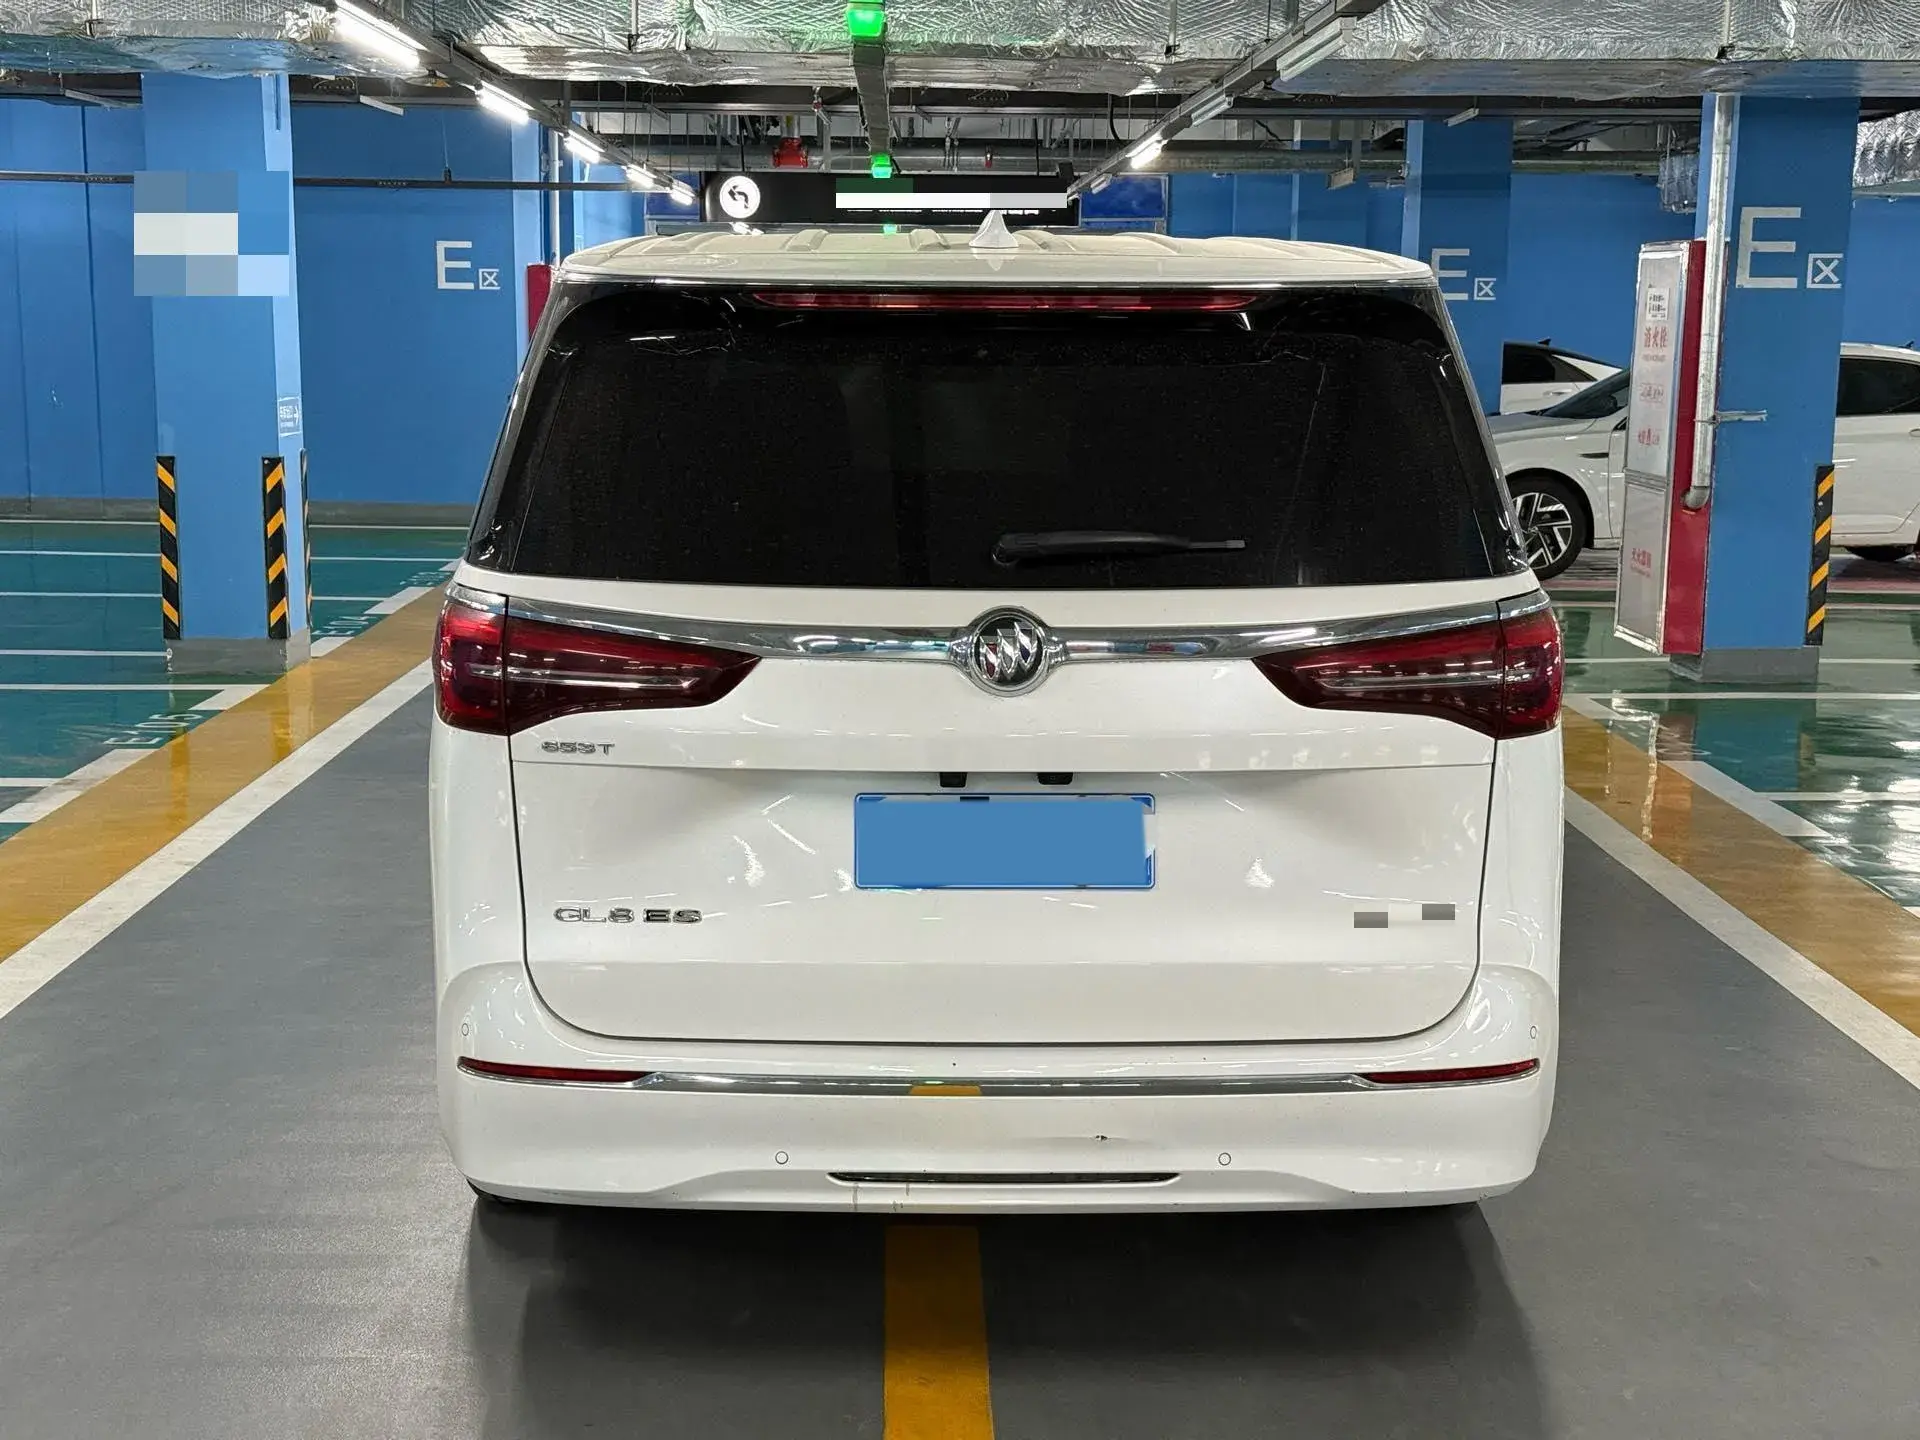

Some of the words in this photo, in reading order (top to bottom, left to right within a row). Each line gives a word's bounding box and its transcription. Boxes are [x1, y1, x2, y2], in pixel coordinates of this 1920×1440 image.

[436, 240, 501, 290] E区
[1736, 206, 1844, 289] E区
[1431, 248, 1497, 301] E区
[101, 713, 203, 745] E105
[553, 906, 635, 924] GL8
[643, 907, 703, 924] ES
